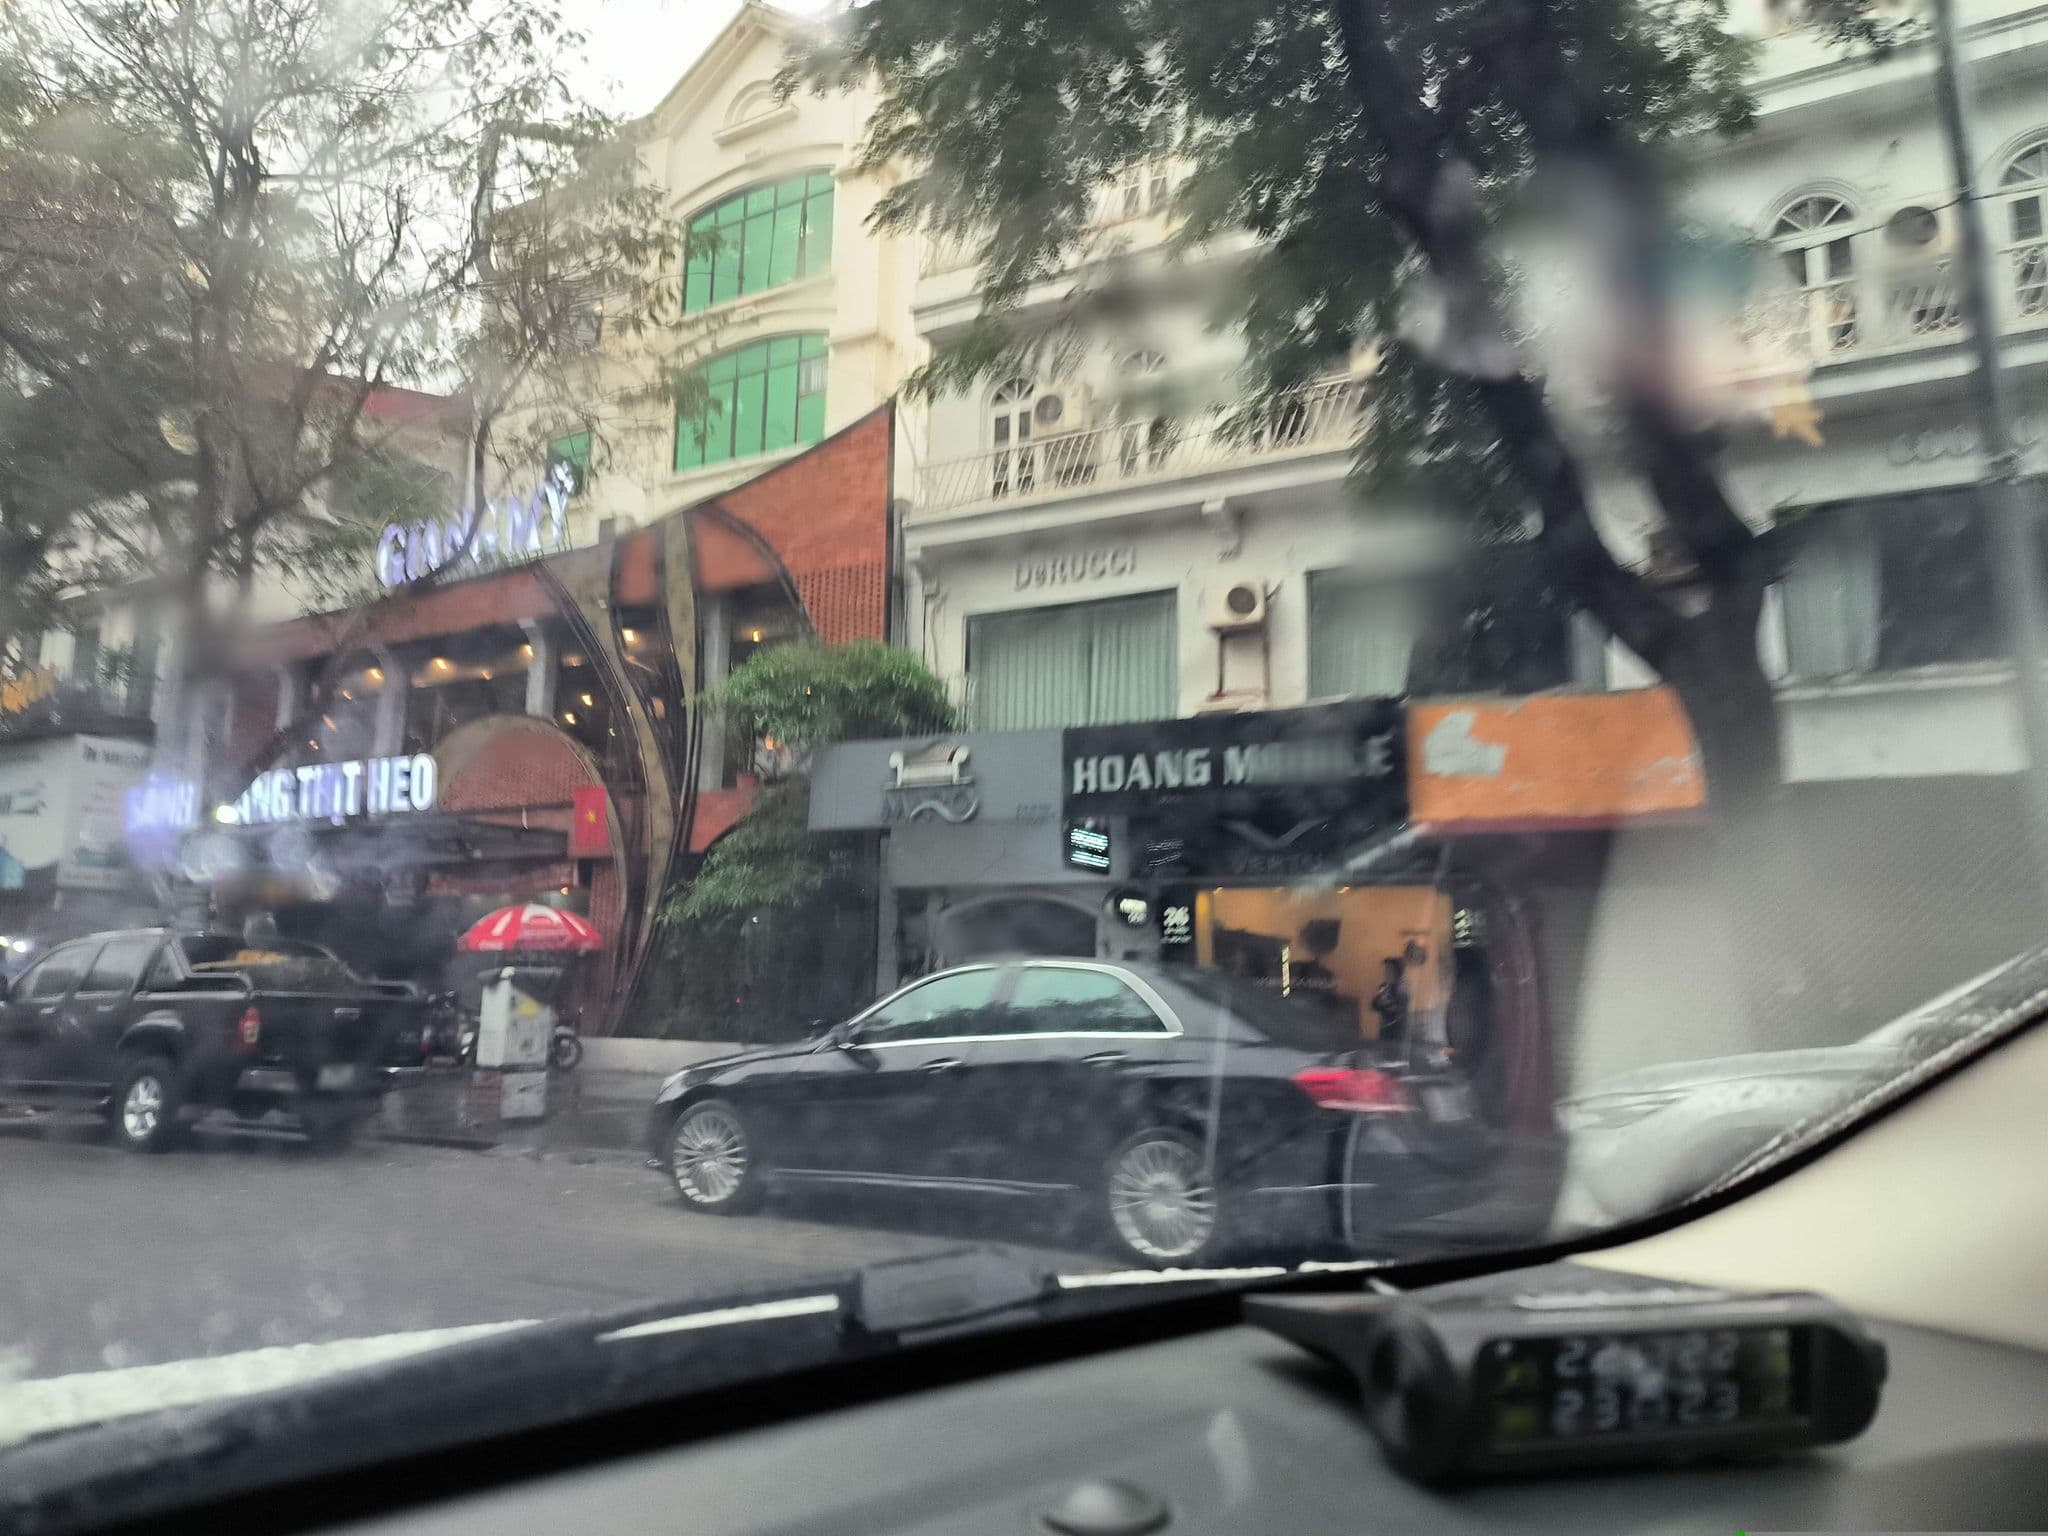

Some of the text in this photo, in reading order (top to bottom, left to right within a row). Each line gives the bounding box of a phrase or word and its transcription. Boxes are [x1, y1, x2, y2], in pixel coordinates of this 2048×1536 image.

[1014, 545, 1137, 591] DeRUCCI
[366, 753, 437, 813] HEO
[1072, 735, 1395, 795] HOANG MLE
